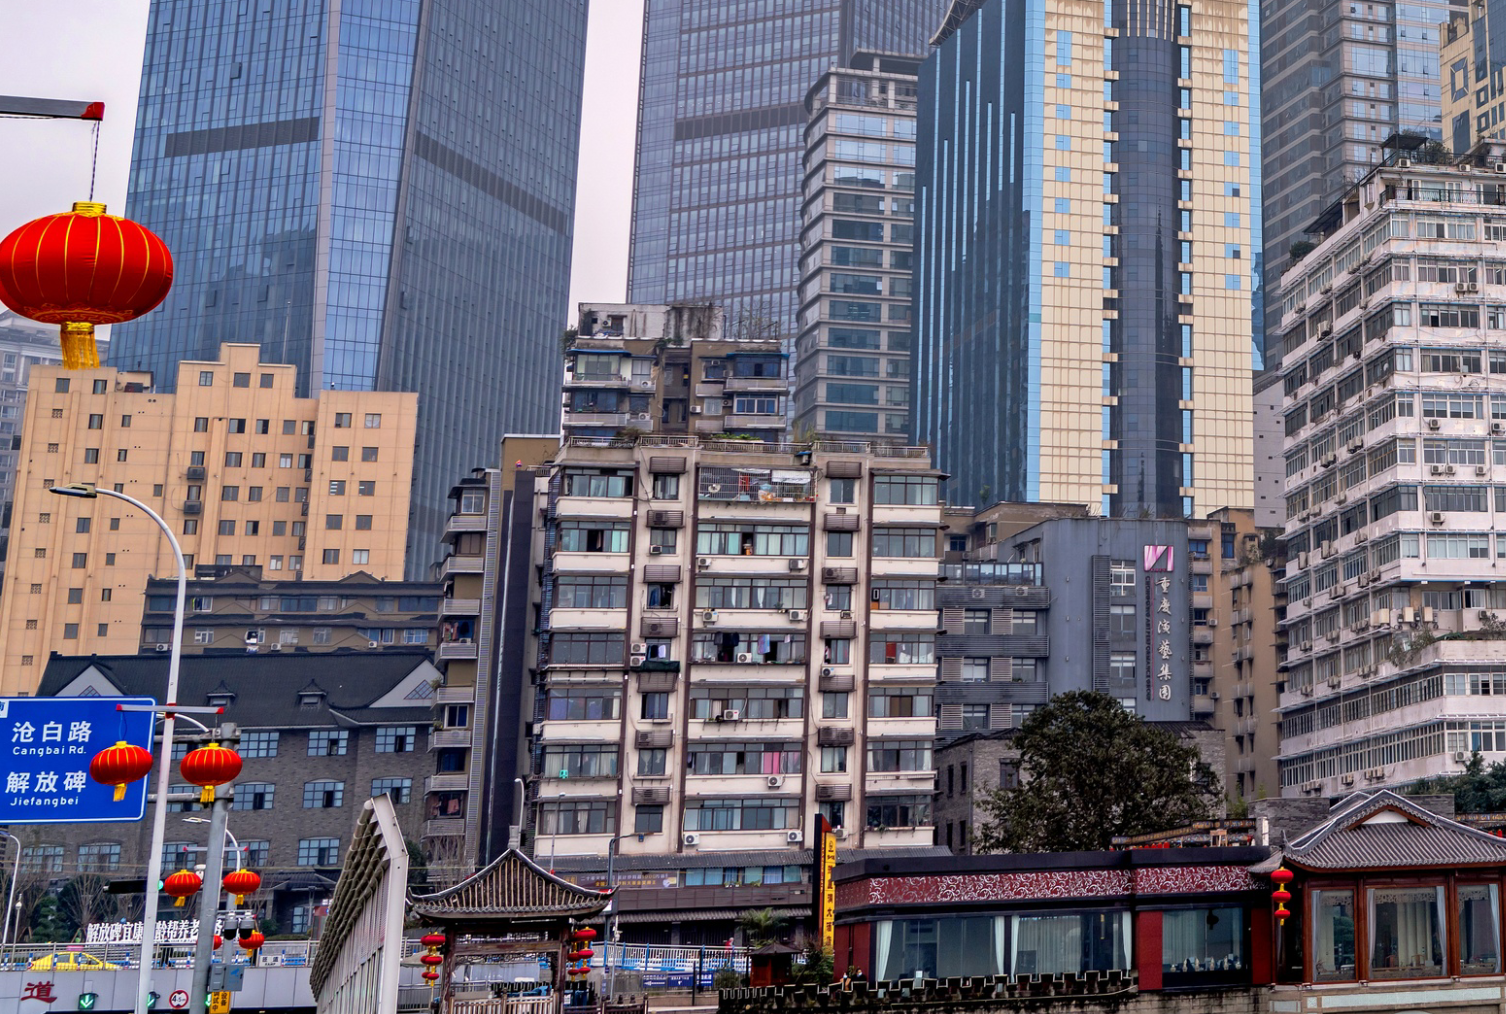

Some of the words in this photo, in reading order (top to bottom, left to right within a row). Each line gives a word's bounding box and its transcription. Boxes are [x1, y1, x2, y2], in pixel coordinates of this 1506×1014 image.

[11, 721, 92, 743] 沧白路
[12, 746, 65, 757] Cangbai
[69, 746, 87, 755] Rd.
[5, 771, 87, 794] 解放碑
[10, 796, 79, 808] Jiefangbei
[20, 980, 58, 1004] 道
